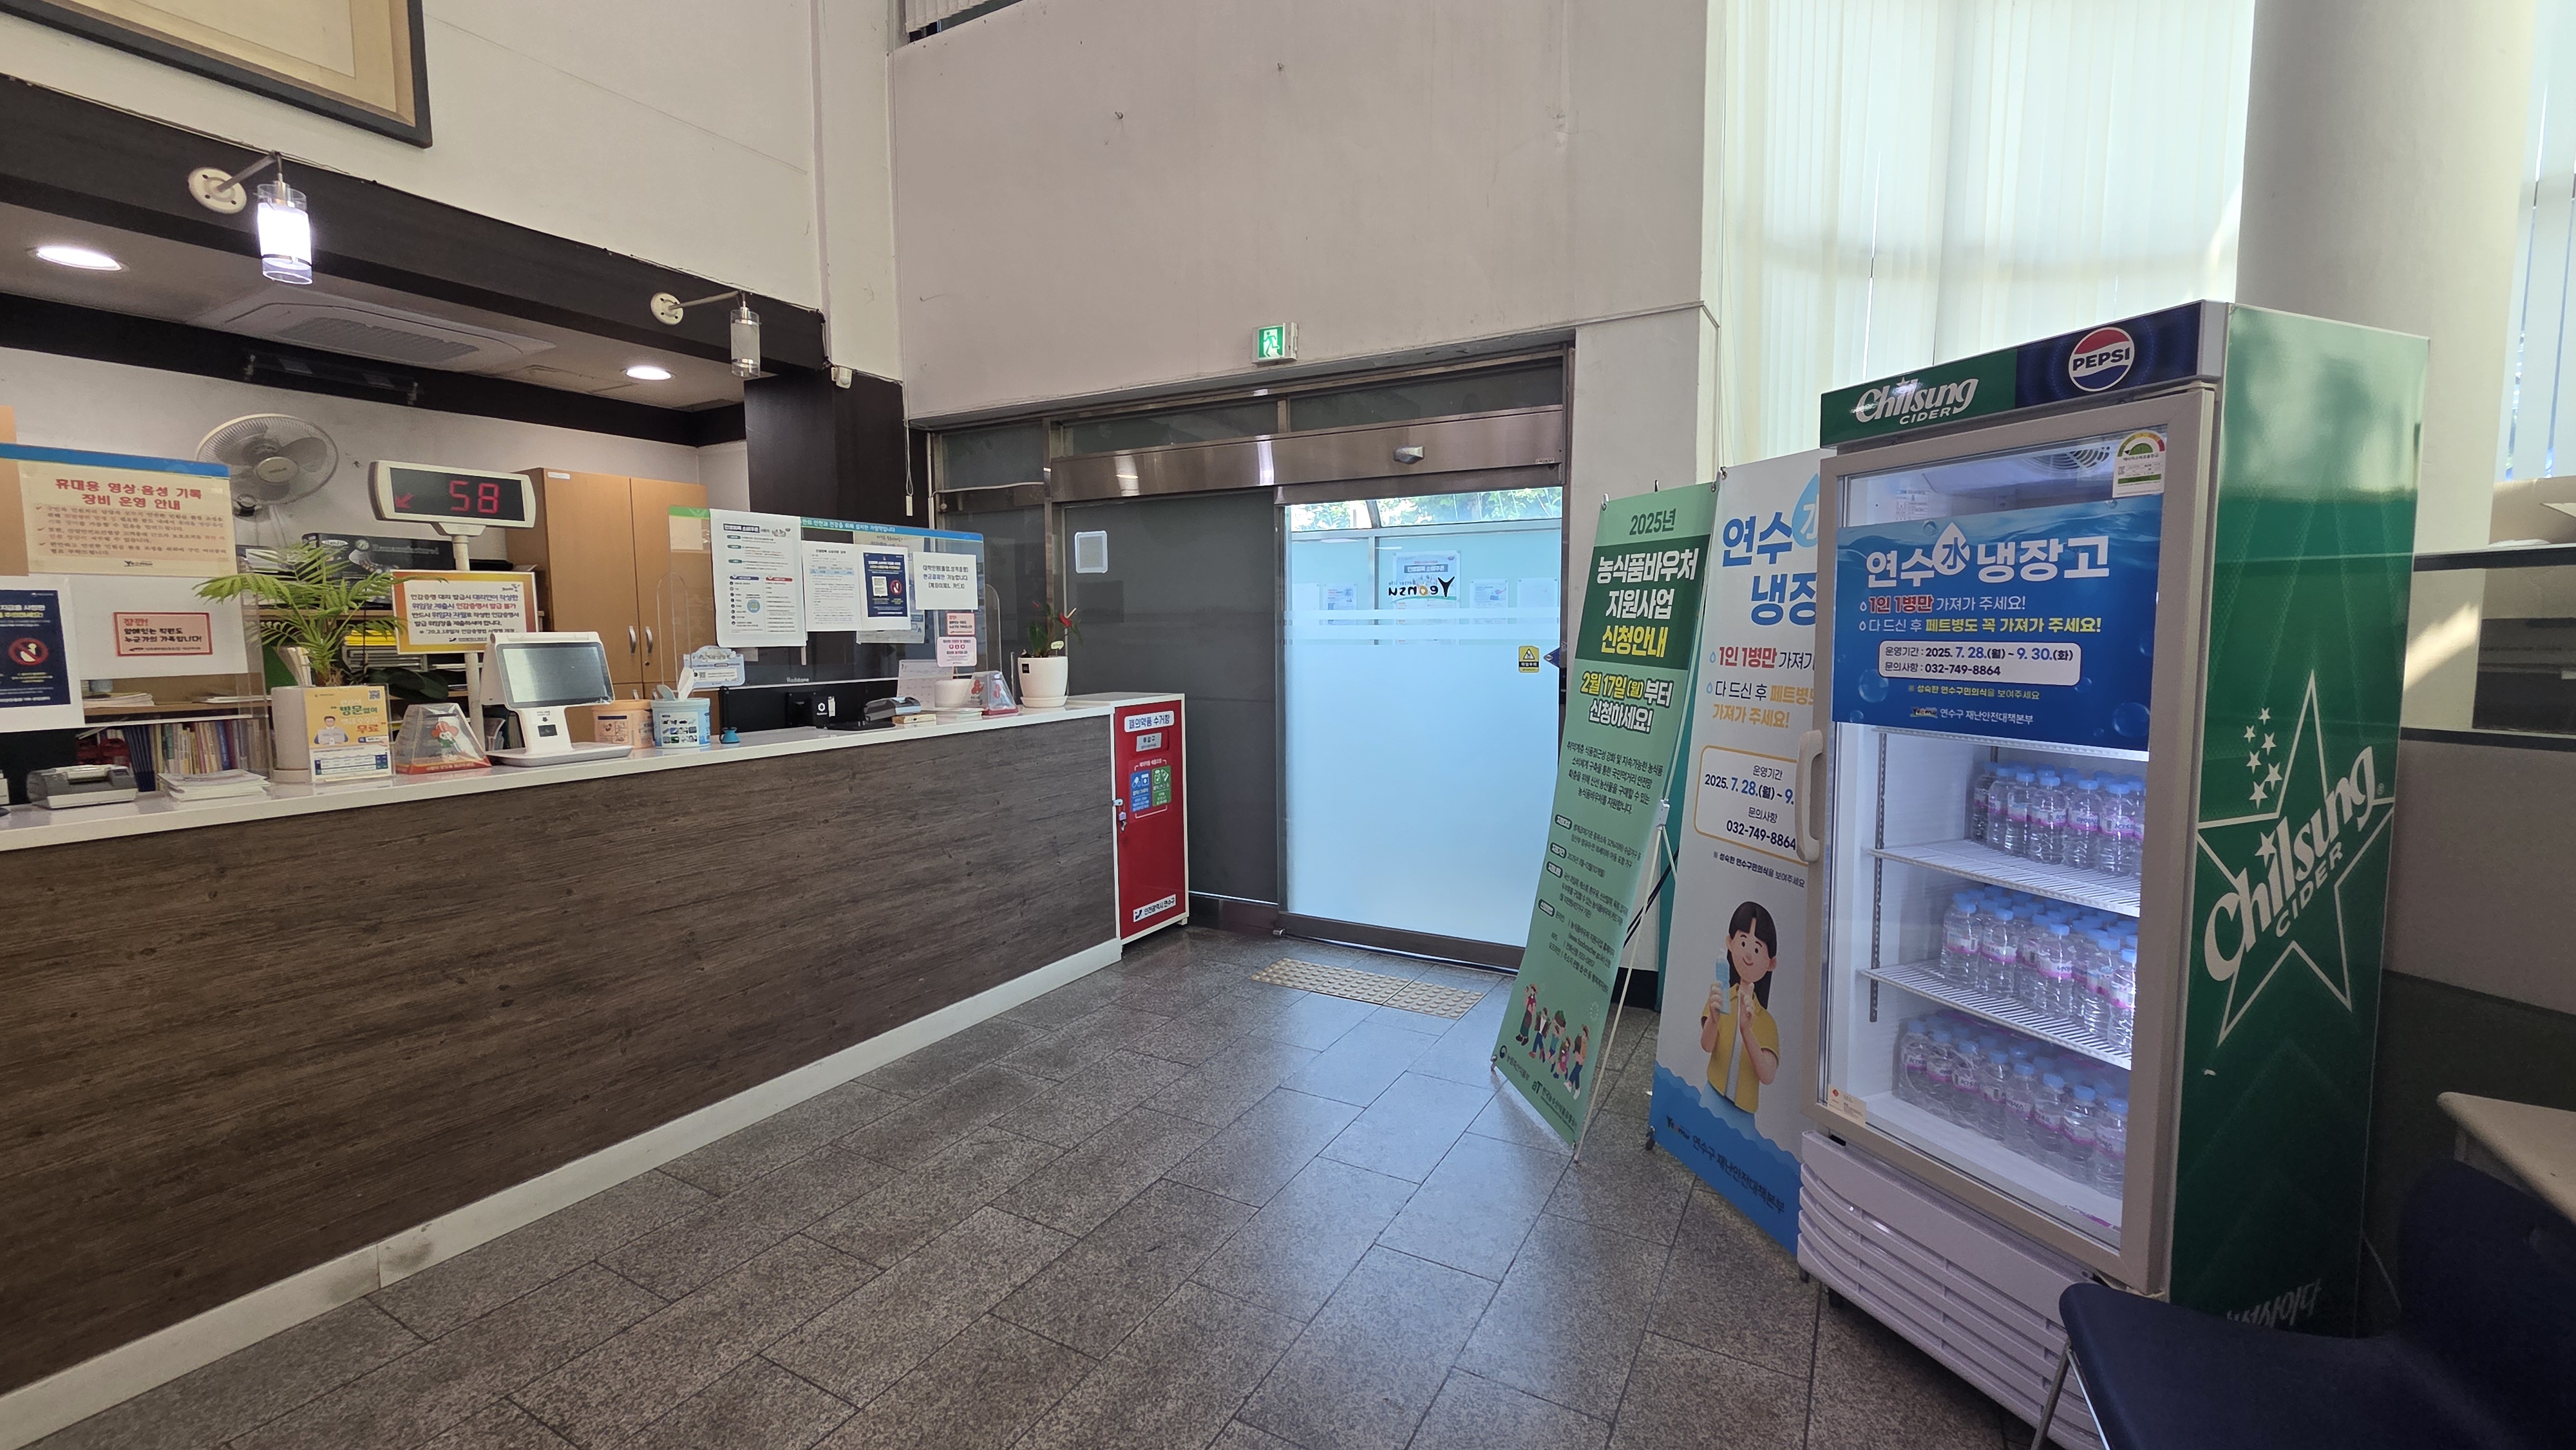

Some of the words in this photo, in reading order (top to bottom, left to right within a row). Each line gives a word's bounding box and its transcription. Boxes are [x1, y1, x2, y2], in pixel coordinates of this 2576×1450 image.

[2072, 346, 2131, 372] PEPSI
[1855, 377, 1979, 424] Chilsung
[1899, 406, 1952, 426] CIDER
[56, 479, 100, 491] 휴대용
[176, 487, 202, 500] 기록
[450, 480, 500, 514] 58
[82, 494, 111, 505] 장비
[119, 496, 146, 508] 운영
[155, 499, 181, 511] 안내
[1629, 509, 1676, 535] 2025년
[1596, 548, 1699, 584] 농식품바우처
[1977, 536, 2110, 583] 냉장고
[1605, 588, 1674, 619] 지원사업
[1869, 596, 1891, 613] 1인
[1895, 595, 1934, 613] 1병만
[1936, 597, 1976, 612] 가져가
[1979, 596, 2025, 611] 주세요!
[1869, 619, 1881, 632] 다
[1883, 619, 1908, 632] 드신
[1910, 619, 1922, 632] 후
[1926, 618, 1978, 632] 페트병도
[1982, 617, 1996, 633] 꼭
[2000, 617, 2044, 633] 가져가
[2048, 617, 2102, 633] 주세요!
[1601, 625, 1669, 657] 신청안내
[1885, 646, 1919, 656] 운영기간
[1925, 647, 1953, 658] 2025.
[1955, 647, 1964, 658] 7.
[2016, 648, 2027, 660] 9.
[1719, 646, 1739, 666] 1인
[1742, 647, 1777, 668] 1병만
[1885, 662, 1918, 672] 문의사항
[1925, 664, 2001, 675] 032-749-8864
[1581, 671, 1601, 694] 2월
[1716, 681, 1727, 697] 다
[1728, 682, 1752, 699] 드신
[1755, 684, 1767, 701] 후
[1917, 684, 1939, 694] 성숙한
[1940, 686, 1995, 697] 연수구민의식을
[1997, 690, 2040, 700] 보여주세요
[1129, 717, 1152, 729] 폐의약품
[1153, 714, 1170, 725] 수거함
[1589, 699, 1654, 733] 신청하세요!
[1712, 704, 1746, 723] 가져가
[1749, 708, 1790, 729] 주세요!
[1940, 709, 1964, 719] 연수구
[1965, 710, 2034, 724] 재난안전대책본부
[1622, 756, 1647, 772] 지속가능한
[1648, 763, 1663, 777] 농식품
[1753, 765, 1783, 781] 운영기간
[1704, 774, 1728, 789] 2025.
[1731, 777, 1738, 792] 7.
[1785, 789, 1794, 805] 9.
[1748, 807, 1777, 824] 문의사항
[1727, 820, 1796, 850] 032-749-8864
[1719, 853, 1735, 864] 성숙한
[1736, 858, 1774, 878] 연수구민의식을
[1775, 871, 1805, 888] 보여주세요
[2204, 745, 2376, 982] Chilsung
[2275, 841, 2344, 938] CIDER
[1692, 1136, 1715, 1161] 연수구
[1716, 1153, 1785, 1214] 재난안전대책본부
